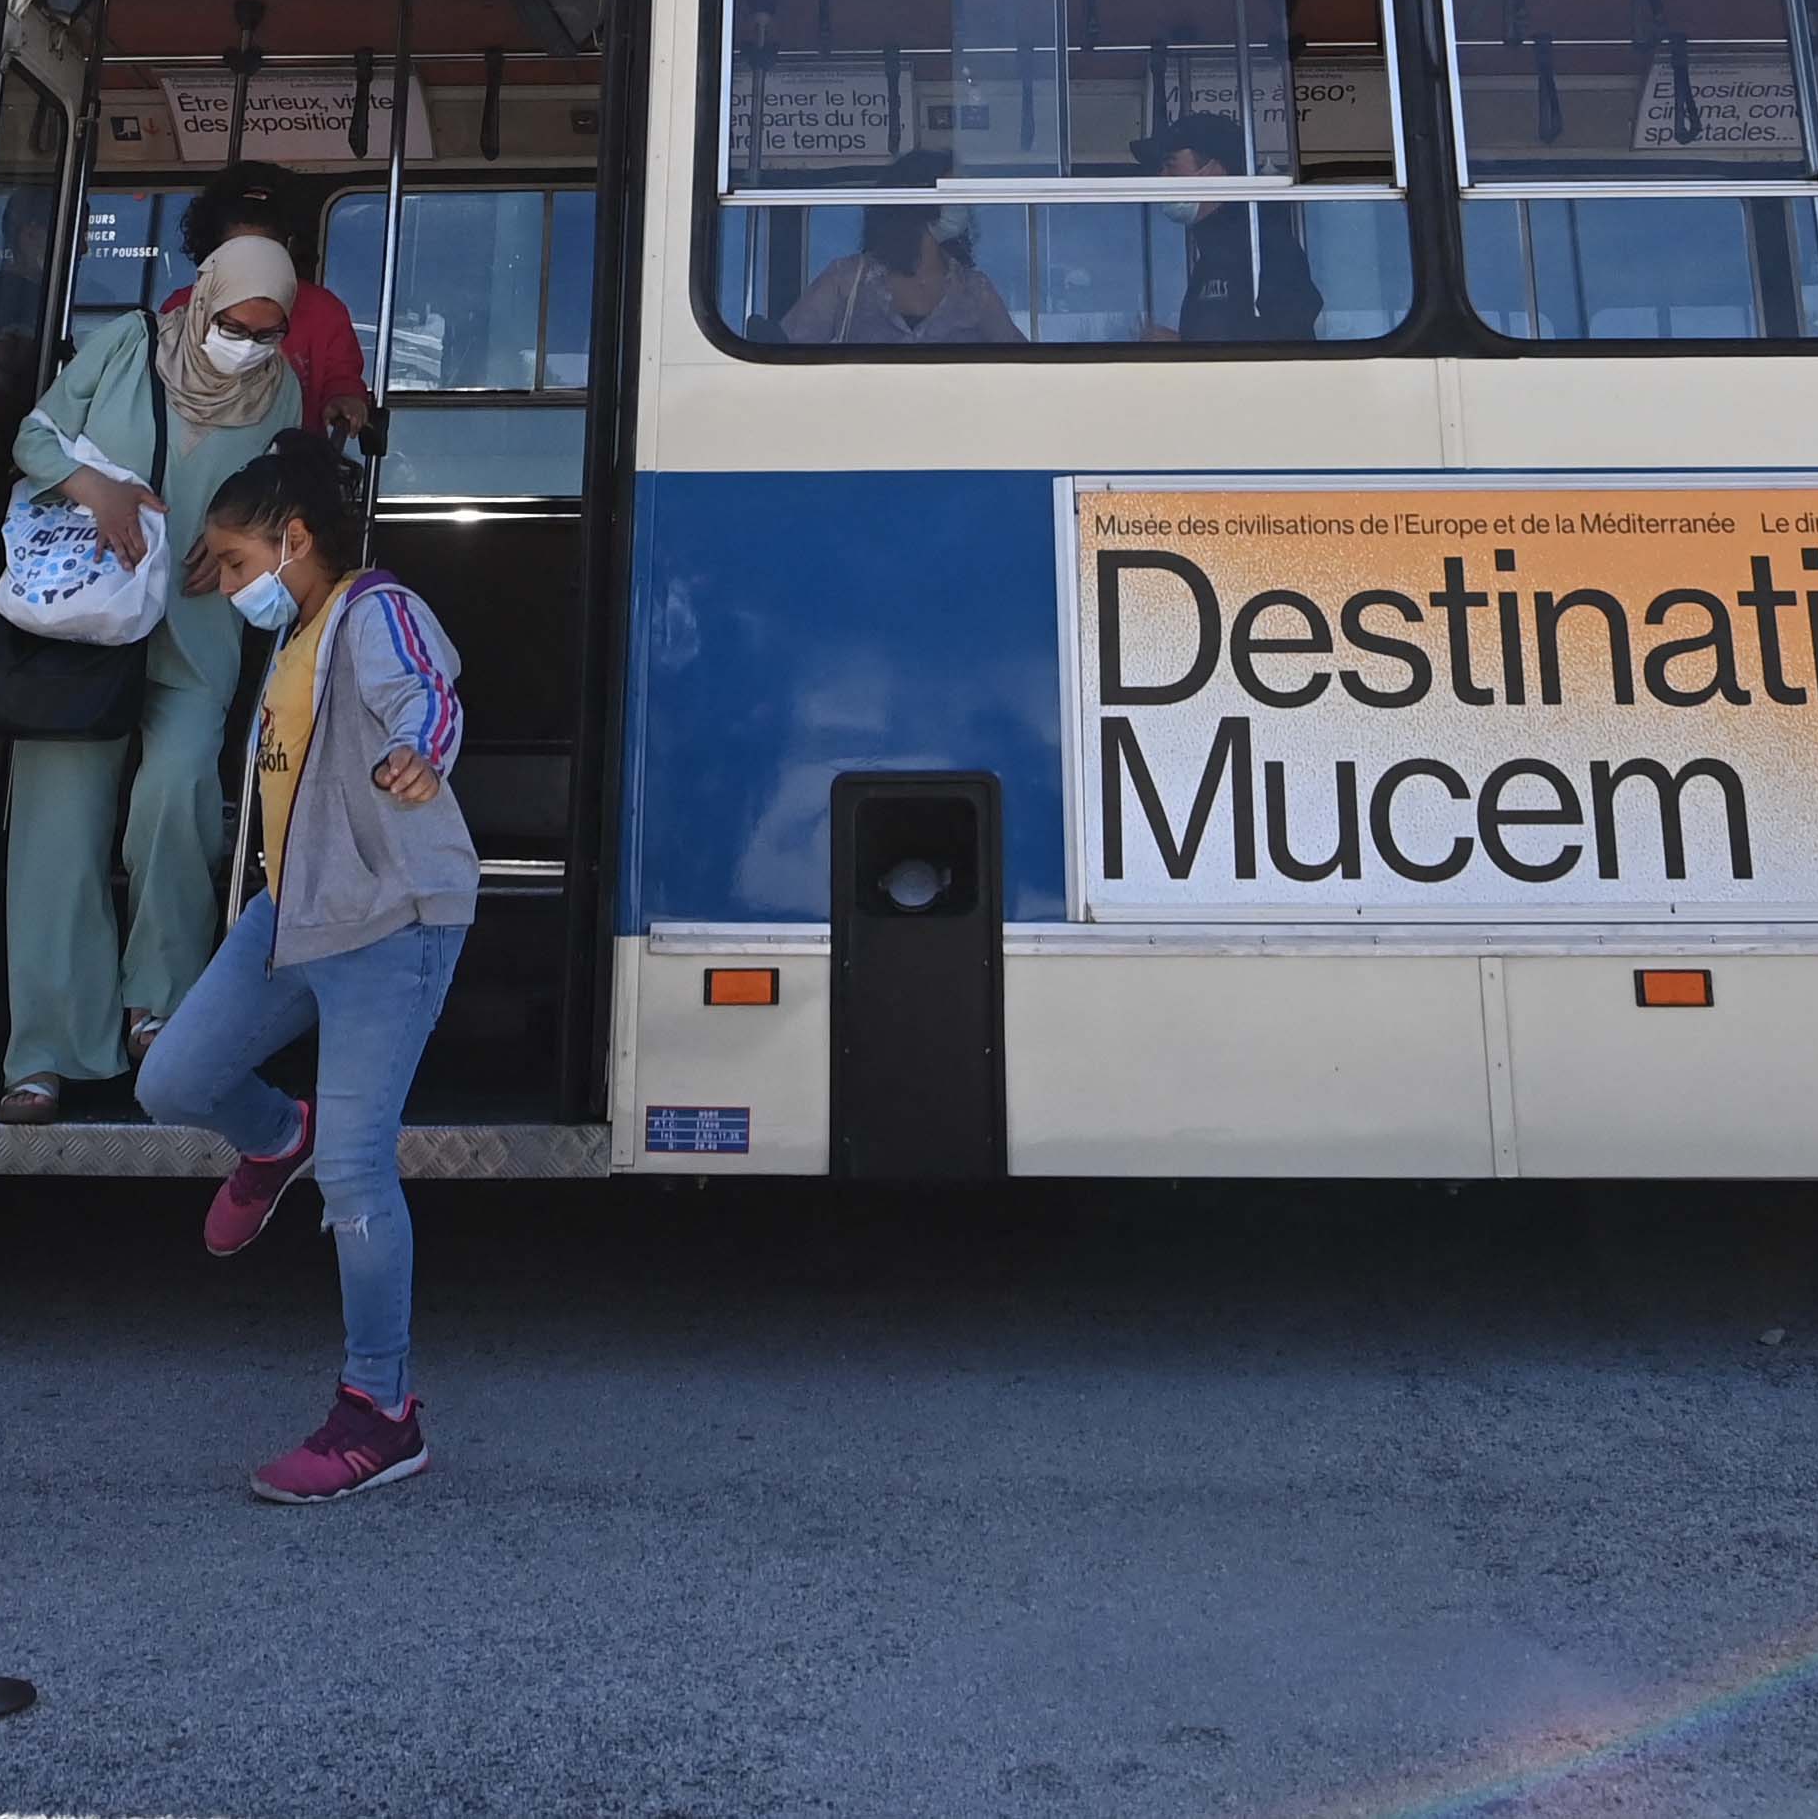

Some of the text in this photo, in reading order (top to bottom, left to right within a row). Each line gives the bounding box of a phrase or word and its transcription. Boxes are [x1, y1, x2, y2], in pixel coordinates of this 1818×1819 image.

[177, 92, 229, 112] Être
[184, 115, 229, 133] des
[825, 110, 853, 127] du
[793, 132, 866, 152] temps
[112, 246, 159, 259] POUSSER
[1095, 511, 1735, 540] Musée des civilisations de l'Europe et de la Méditerranée
[1760, 513, 1790, 534] Le
[1100, 716, 1754, 884] Mucem
